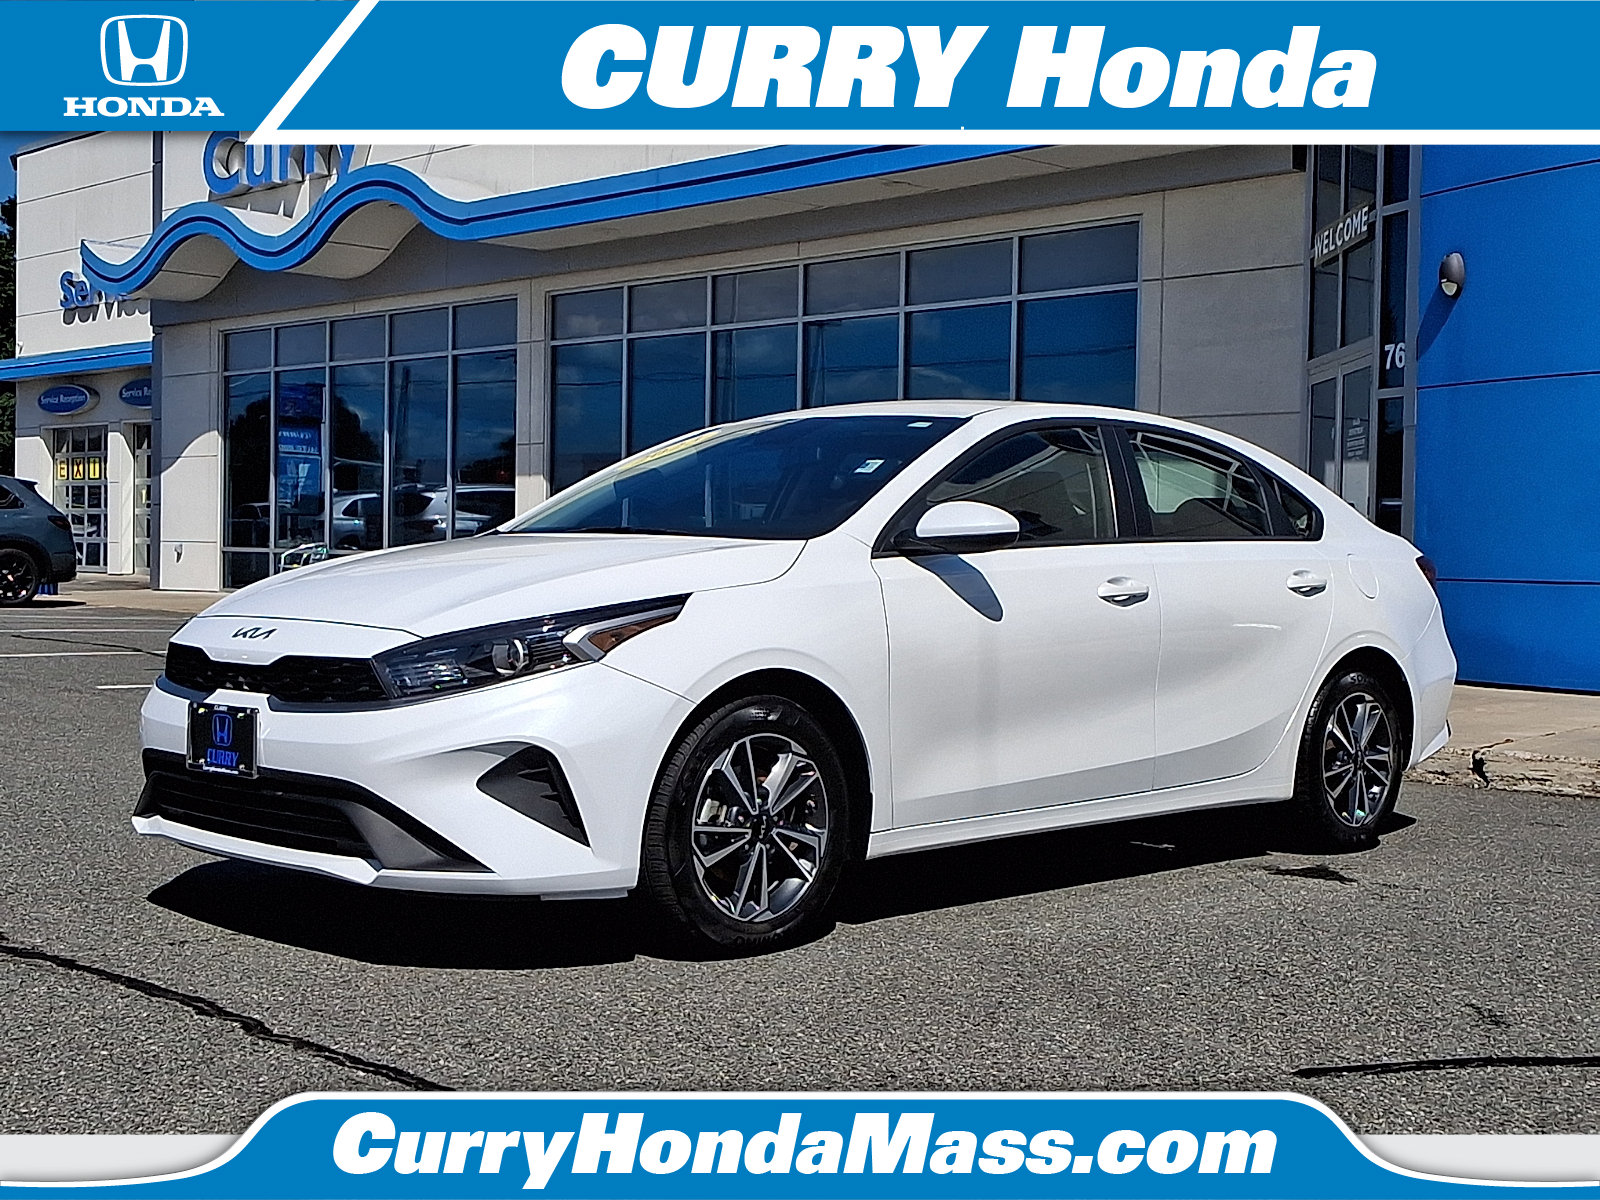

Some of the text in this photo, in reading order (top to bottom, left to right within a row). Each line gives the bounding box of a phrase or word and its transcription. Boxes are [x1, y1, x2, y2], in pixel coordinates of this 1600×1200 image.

[1314, 206, 1369, 259] WELCOME
[1384, 342, 1406, 370] 76
[58, 459, 99, 478] EXI
[207, 748, 239, 767] CURRY
